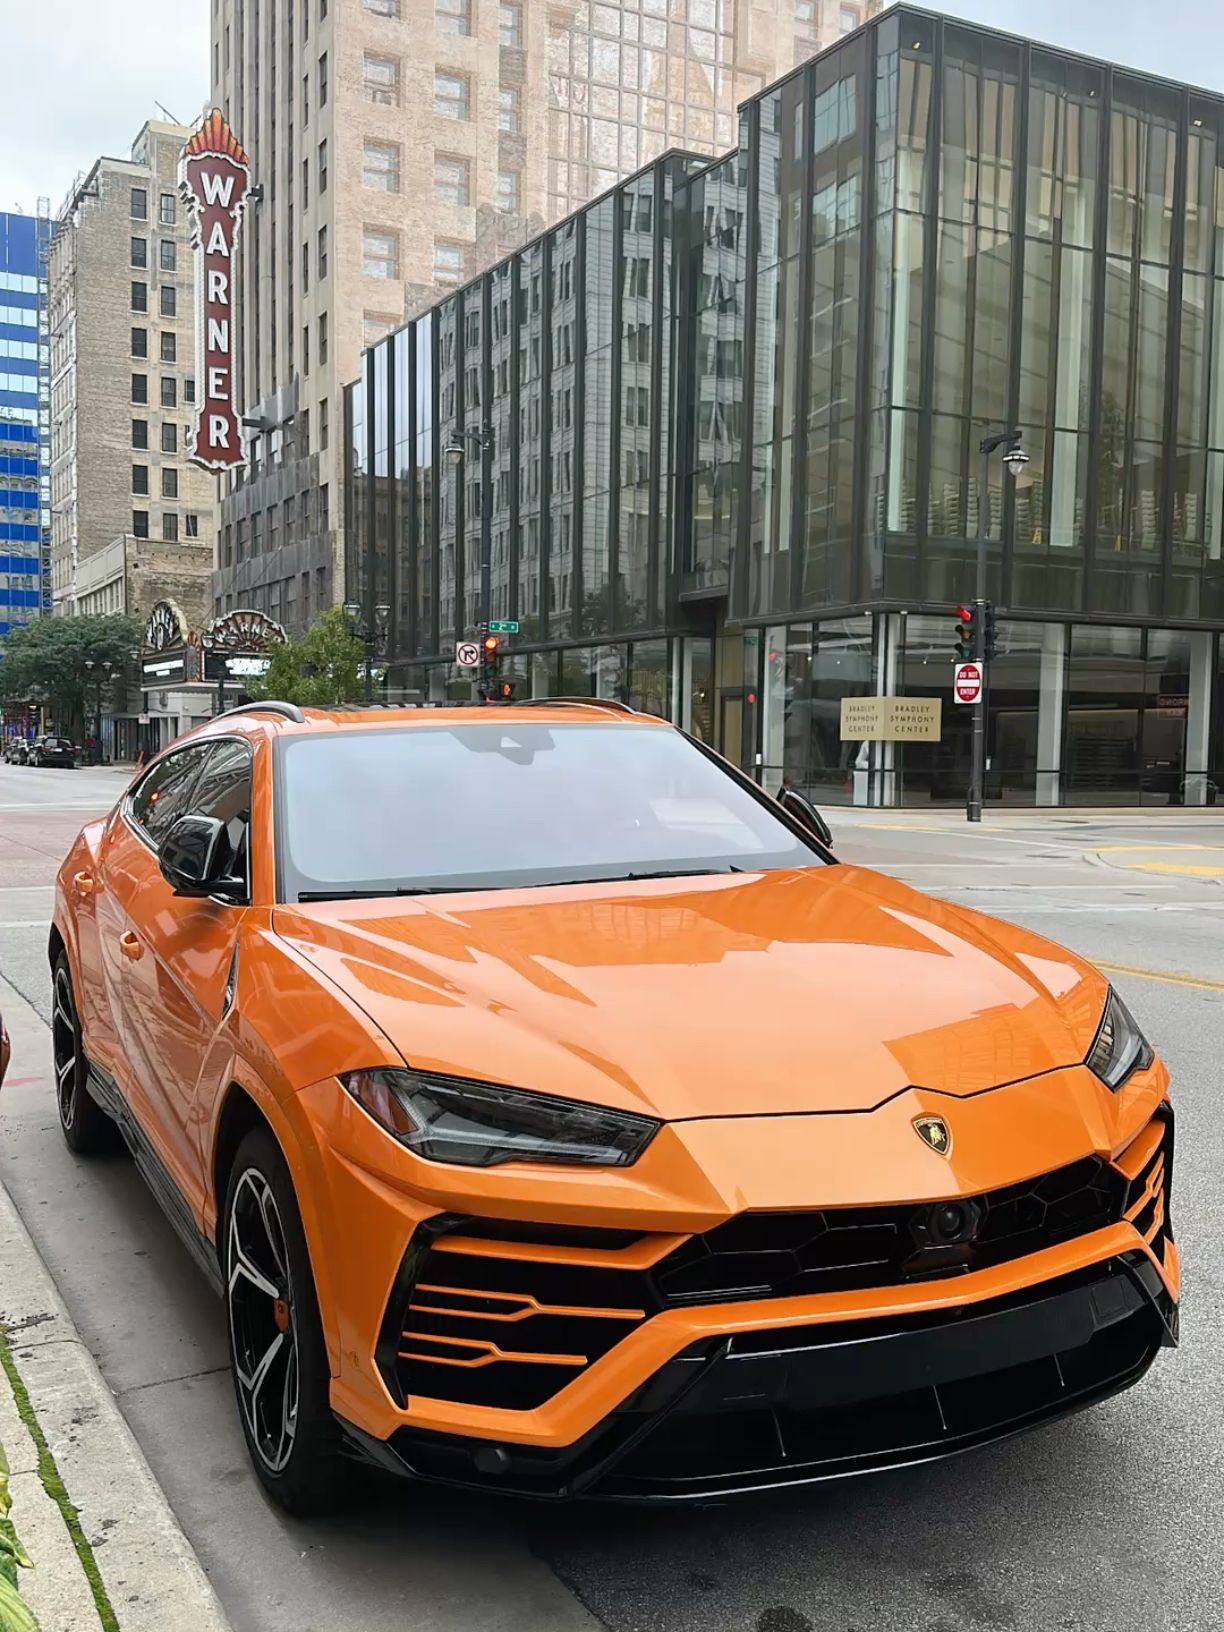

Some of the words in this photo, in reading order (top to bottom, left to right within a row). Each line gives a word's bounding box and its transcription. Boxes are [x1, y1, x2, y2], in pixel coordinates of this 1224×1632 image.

[200, 171, 235, 450] WARNER
[959, 671, 967, 679] DO
[968, 671, 978, 679] NOT
[960, 687, 976, 695] ENTER
[849, 705, 875, 713] BRADLEY
[895, 705, 930, 713] BRADLEY
[845, 715, 879, 723] SYMPHONY
[890, 715, 935, 723] SYMPHONY
[848, 725, 875, 733] CENTER
[894, 725, 930, 733] CENTER
